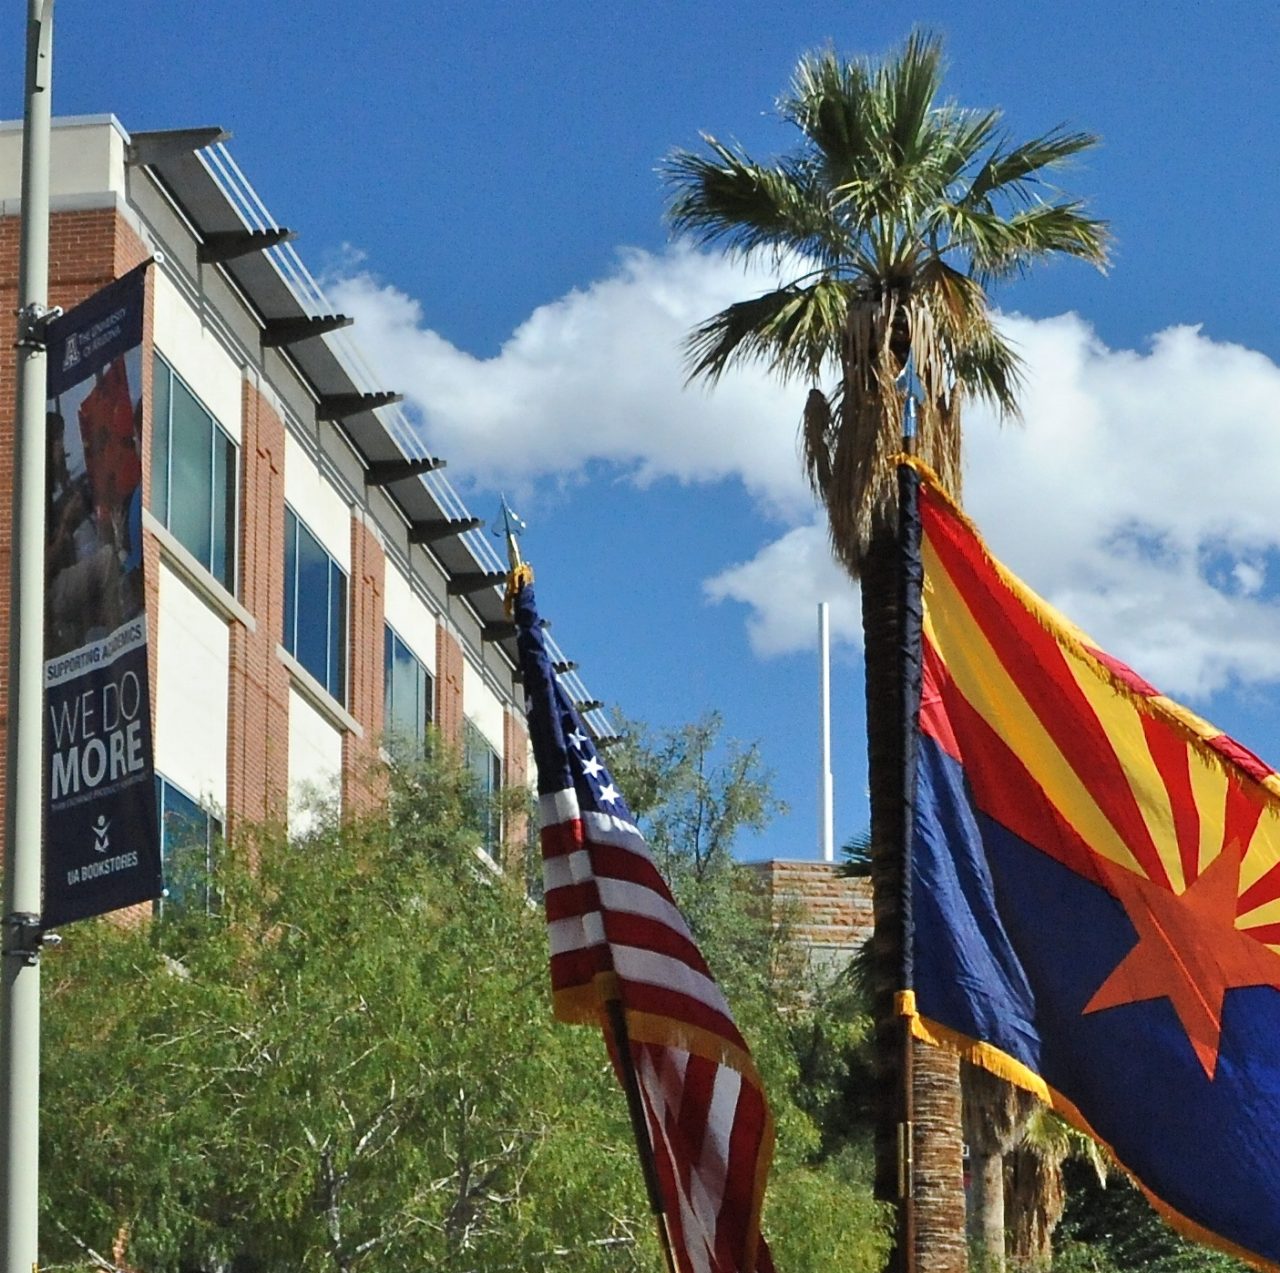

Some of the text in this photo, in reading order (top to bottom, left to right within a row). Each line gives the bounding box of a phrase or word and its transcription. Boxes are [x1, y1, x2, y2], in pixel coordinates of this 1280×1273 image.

[48, 647, 100, 680] SUPPORTING
[51, 670, 140, 747] WE DO
[51, 720, 144, 799] MORE
[67, 852, 138, 886] UA BOOKSTORES
